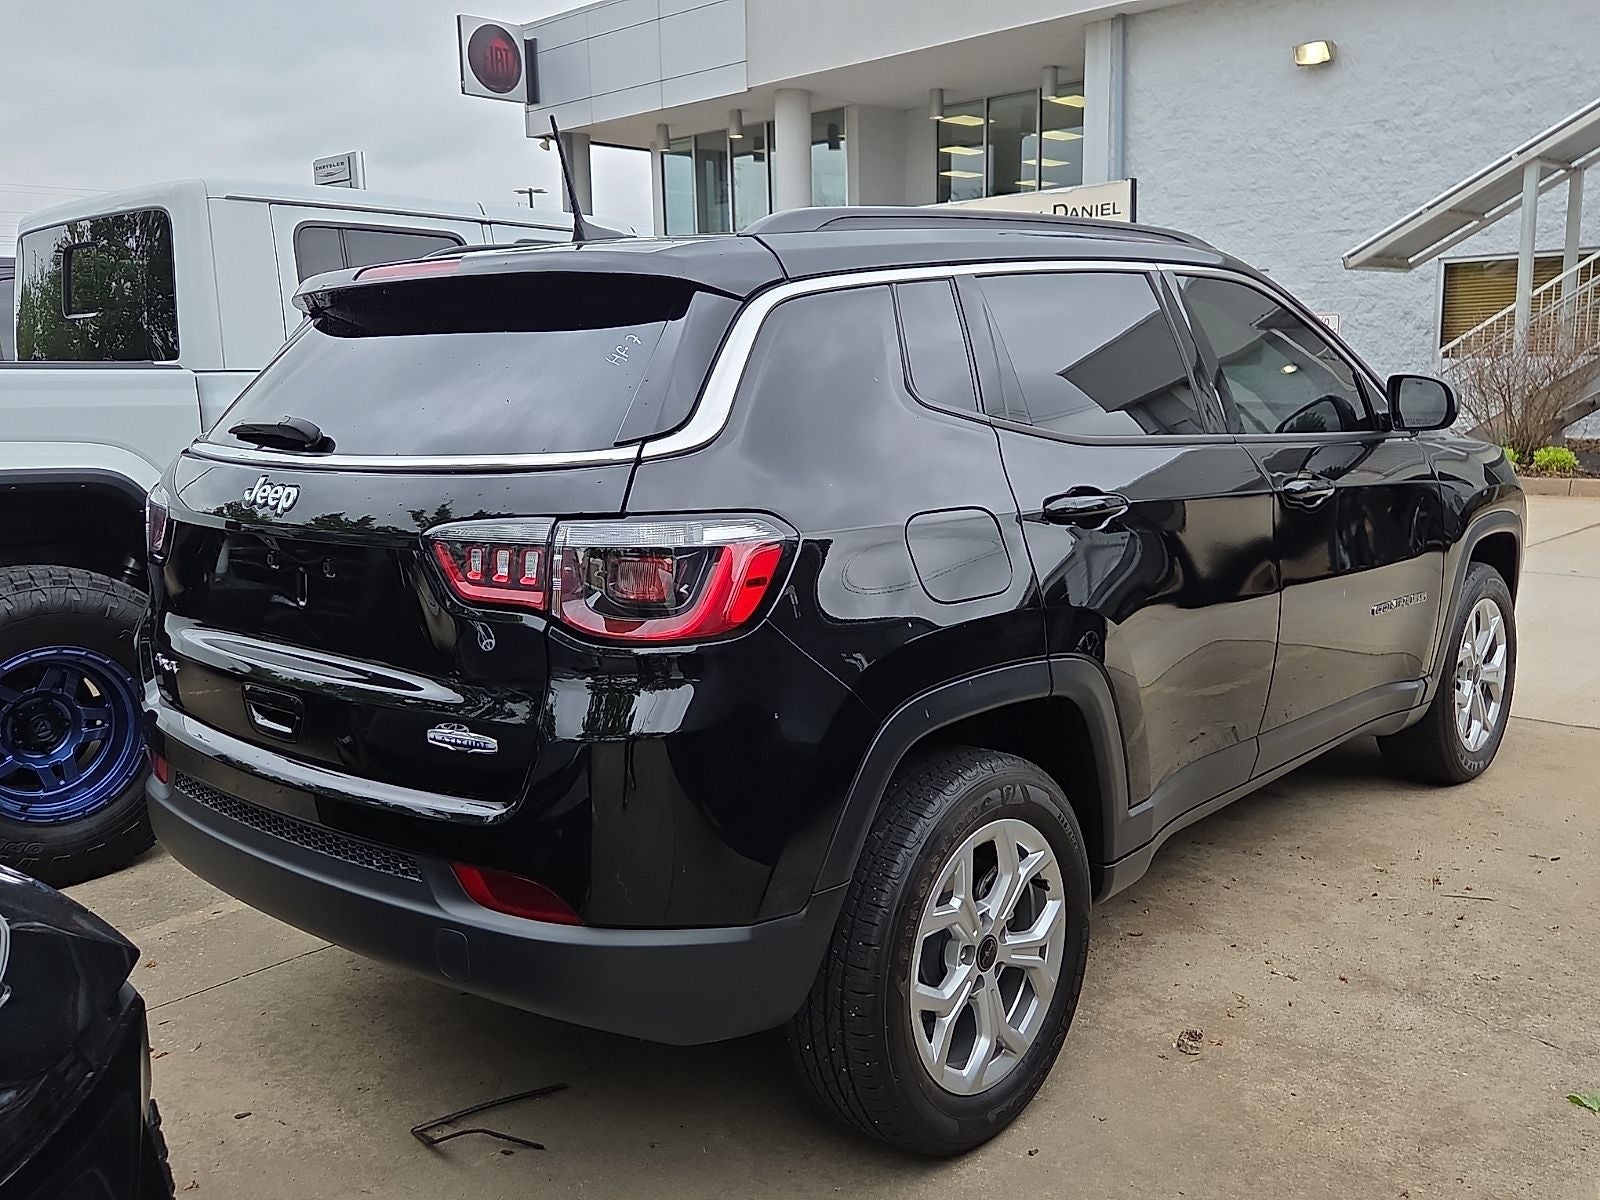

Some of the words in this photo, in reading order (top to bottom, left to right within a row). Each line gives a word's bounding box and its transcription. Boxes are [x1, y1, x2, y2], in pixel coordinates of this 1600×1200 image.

[315, 161, 345, 171] CHRYSLER
[1052, 202, 1122, 218] DANIEL
[242, 474, 301, 518] Jeep
